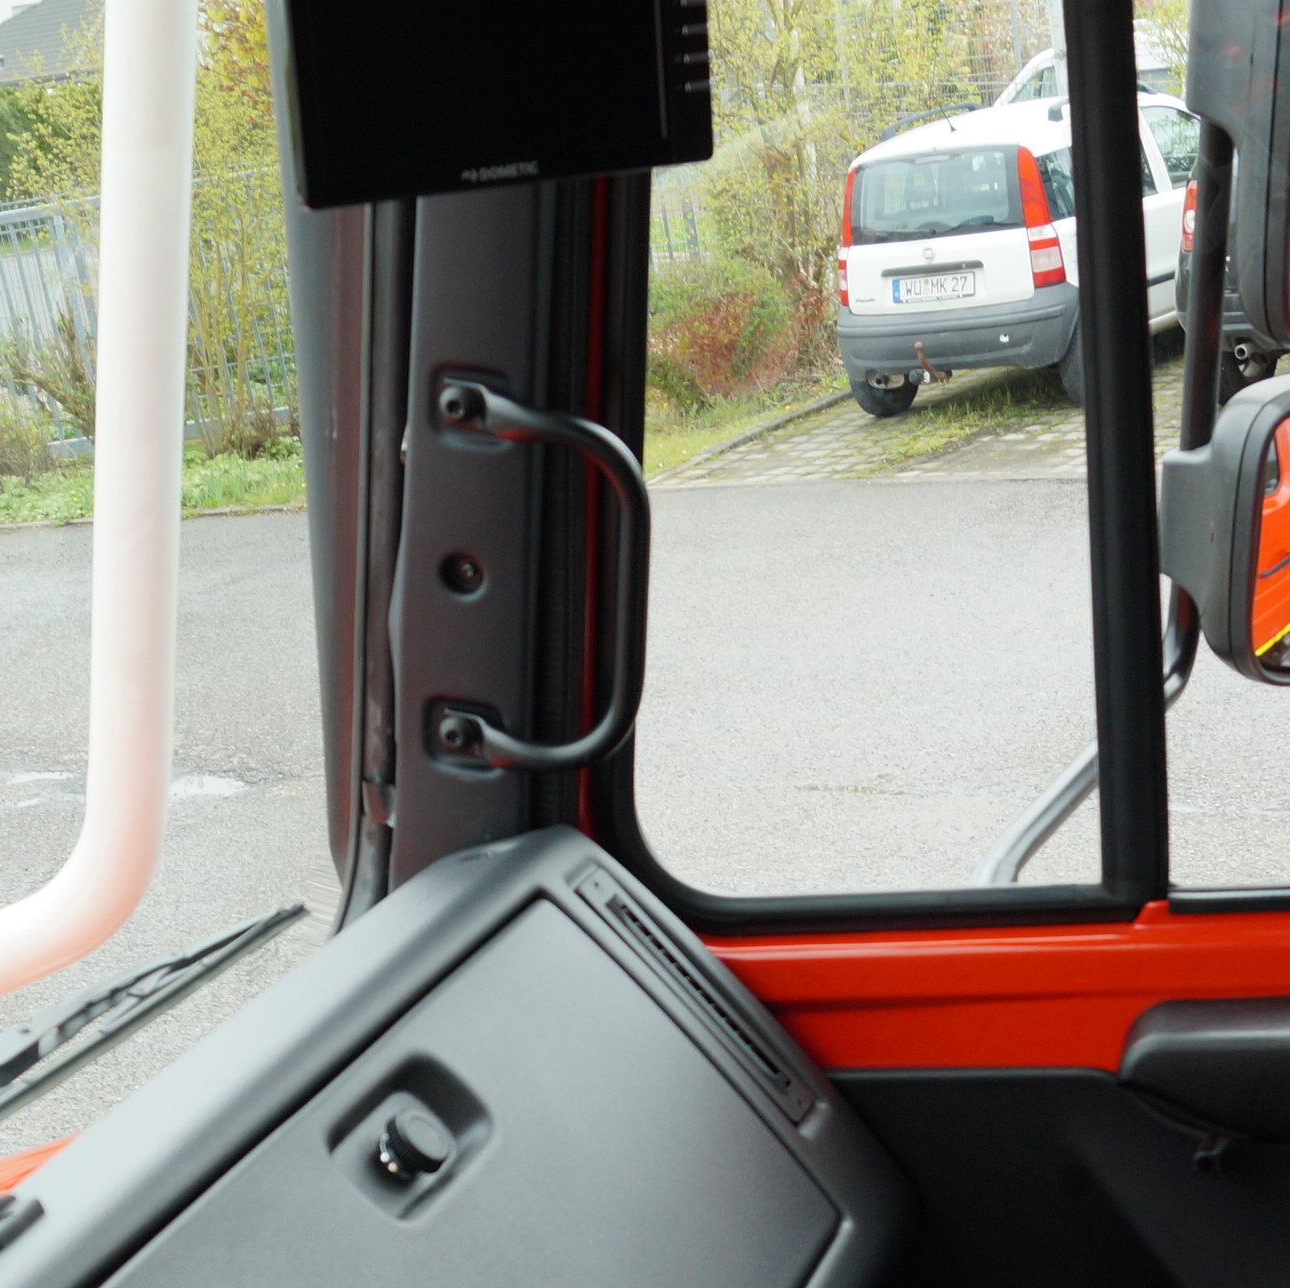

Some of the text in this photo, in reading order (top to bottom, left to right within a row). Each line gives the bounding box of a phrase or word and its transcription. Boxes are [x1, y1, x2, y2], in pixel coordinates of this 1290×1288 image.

[905, 276, 968, 297] WÜ MK 27
